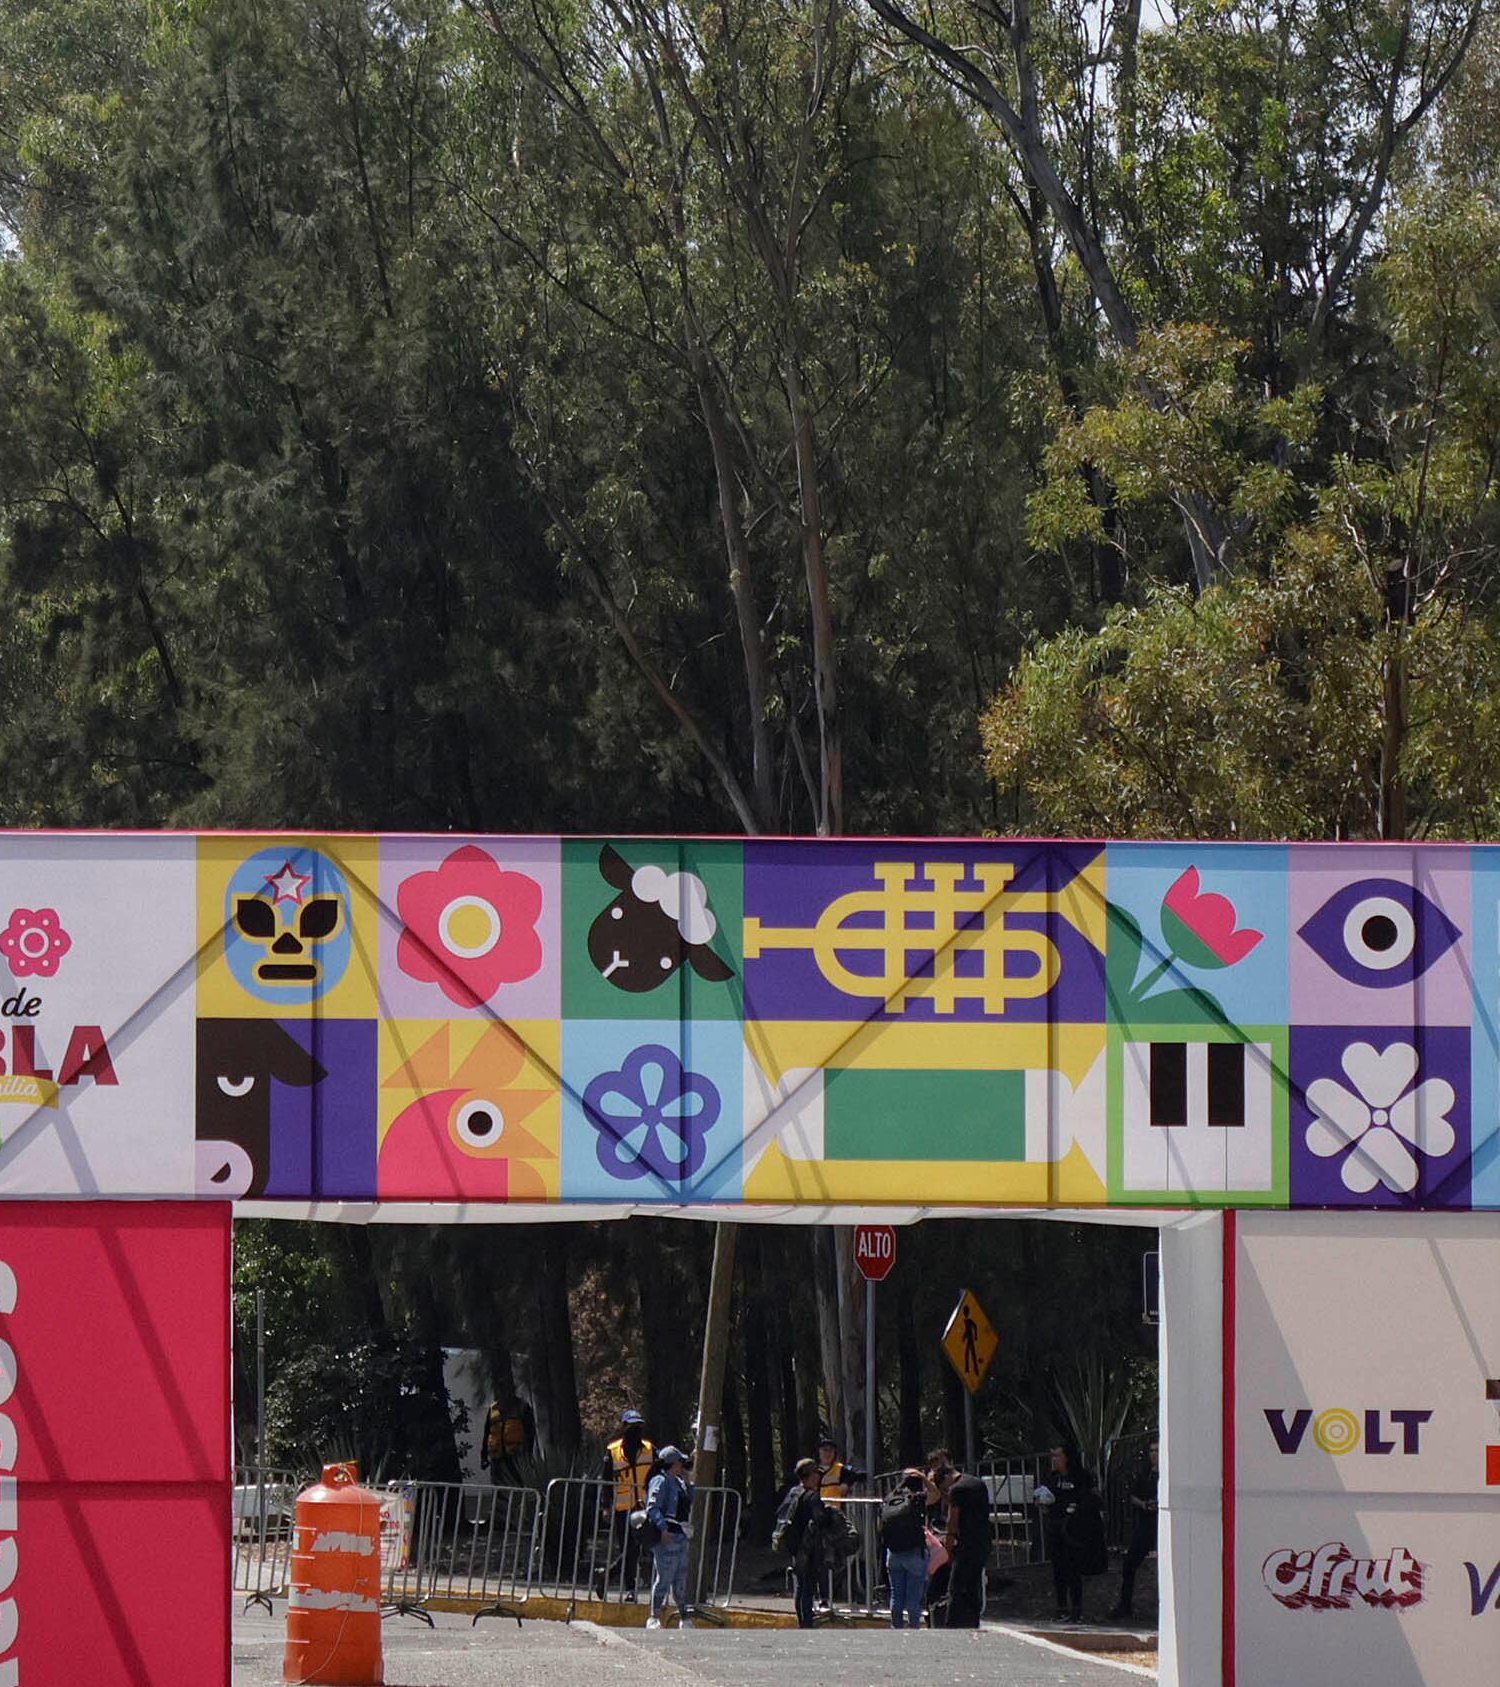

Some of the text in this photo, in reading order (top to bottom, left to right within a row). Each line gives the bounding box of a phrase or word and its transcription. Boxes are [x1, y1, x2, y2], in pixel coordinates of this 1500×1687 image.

[1, 986, 43, 1018] de
[858, 1231, 891, 1258] ALTO
[1263, 1408, 1434, 1455] VOLT
